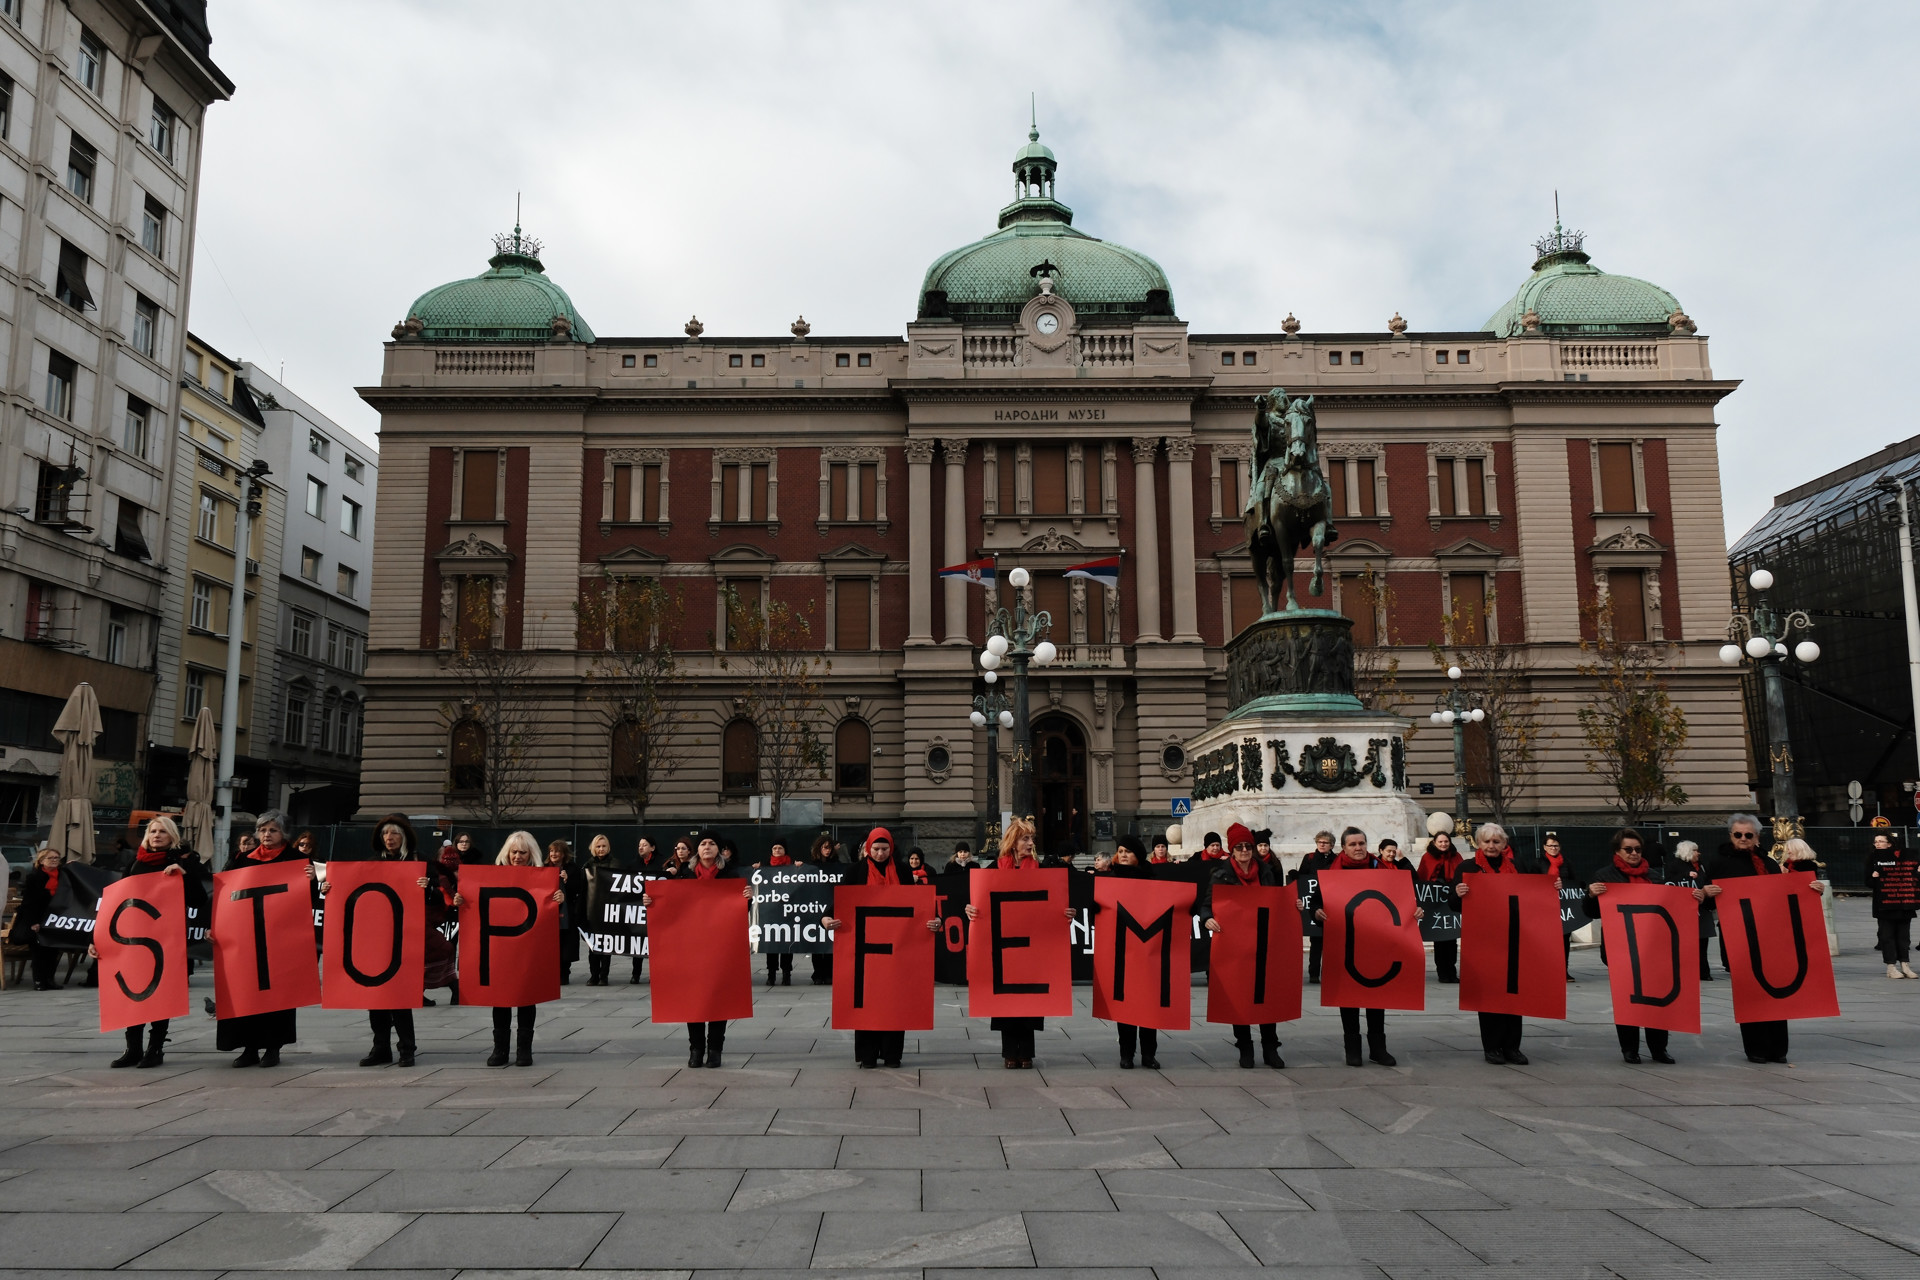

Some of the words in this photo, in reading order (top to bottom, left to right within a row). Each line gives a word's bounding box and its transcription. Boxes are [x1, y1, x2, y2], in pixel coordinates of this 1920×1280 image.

[994, 409, 1059, 421] НАРОДНИ
[1067, 408, 1106, 421] МУЗЕЈ
[609, 871, 668, 894] ZAŠ
[772, 869, 844, 884] decembar
[603, 903, 621, 924] IH
[783, 900, 828, 917] protiv
